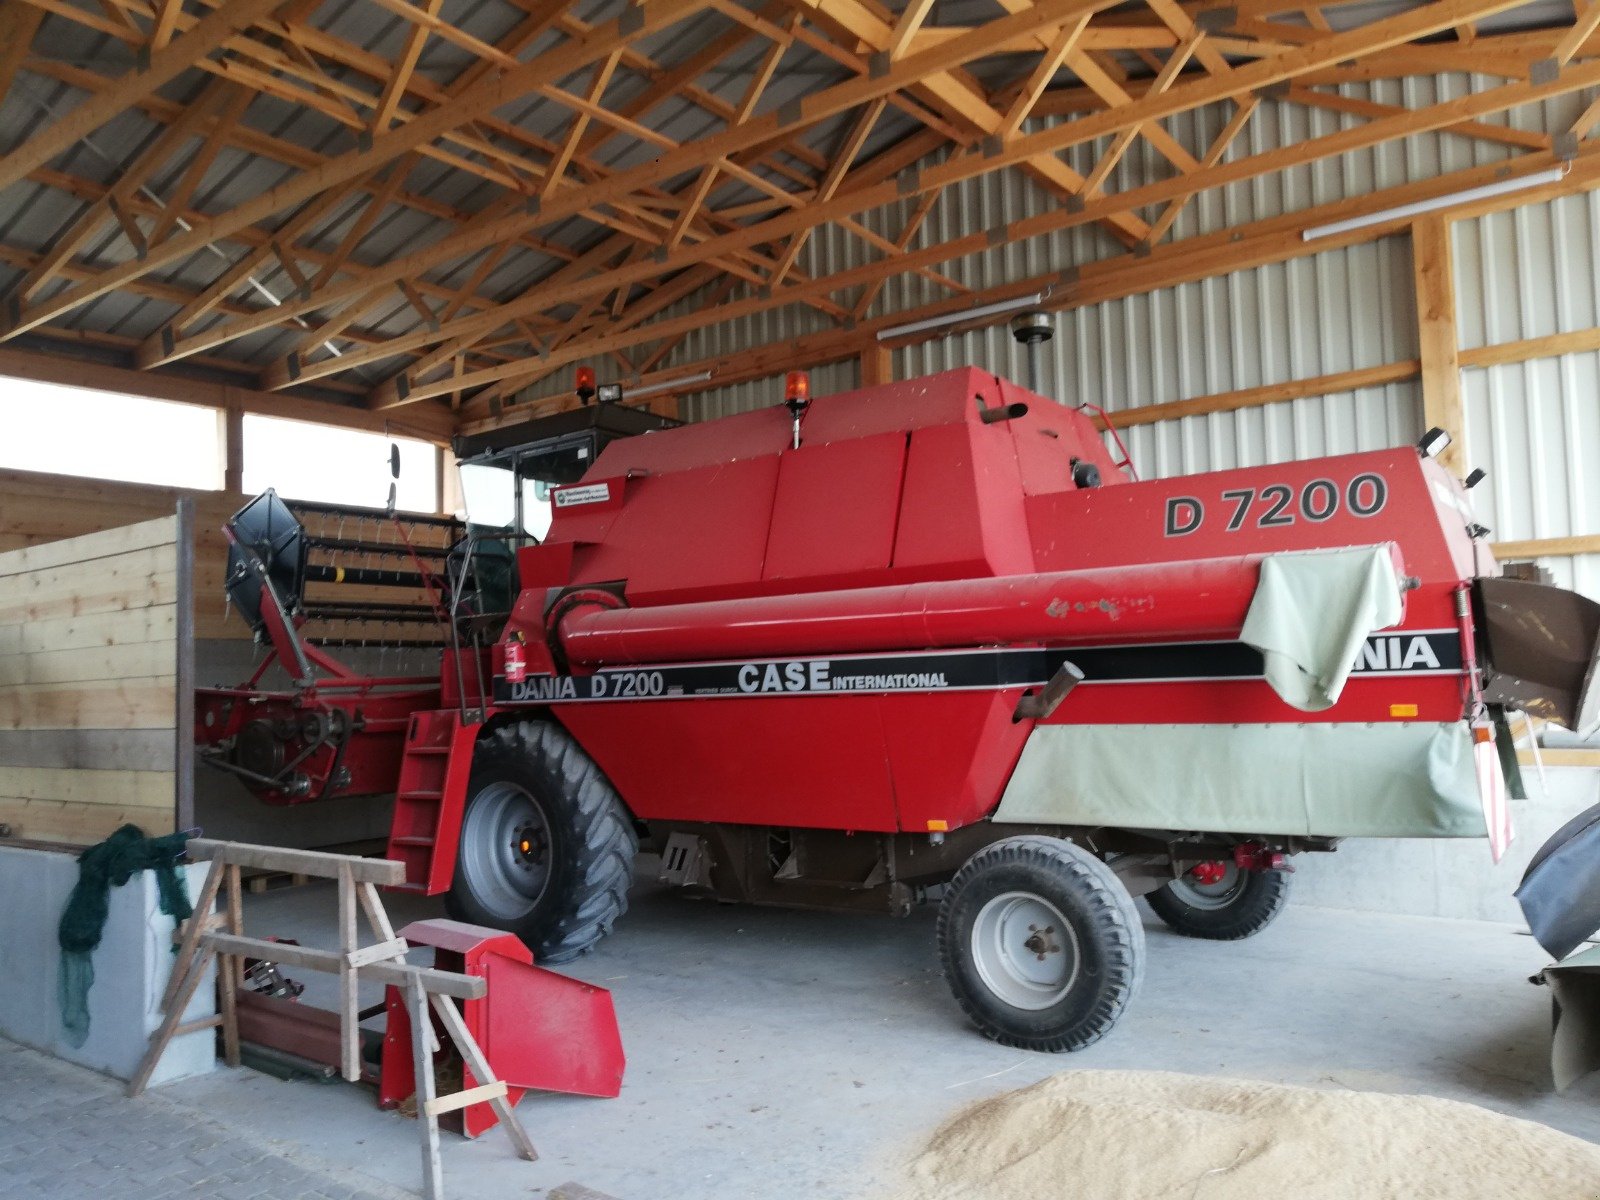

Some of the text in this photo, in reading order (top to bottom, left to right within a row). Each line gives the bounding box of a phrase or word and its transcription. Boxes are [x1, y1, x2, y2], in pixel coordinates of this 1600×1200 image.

[1164, 472, 1388, 538] D 7200
[1352, 636, 1441, 671] NIA
[511, 671, 664, 700] DANIA D 7200
[737, 661, 949, 693] CASE INTERNATIONAL
